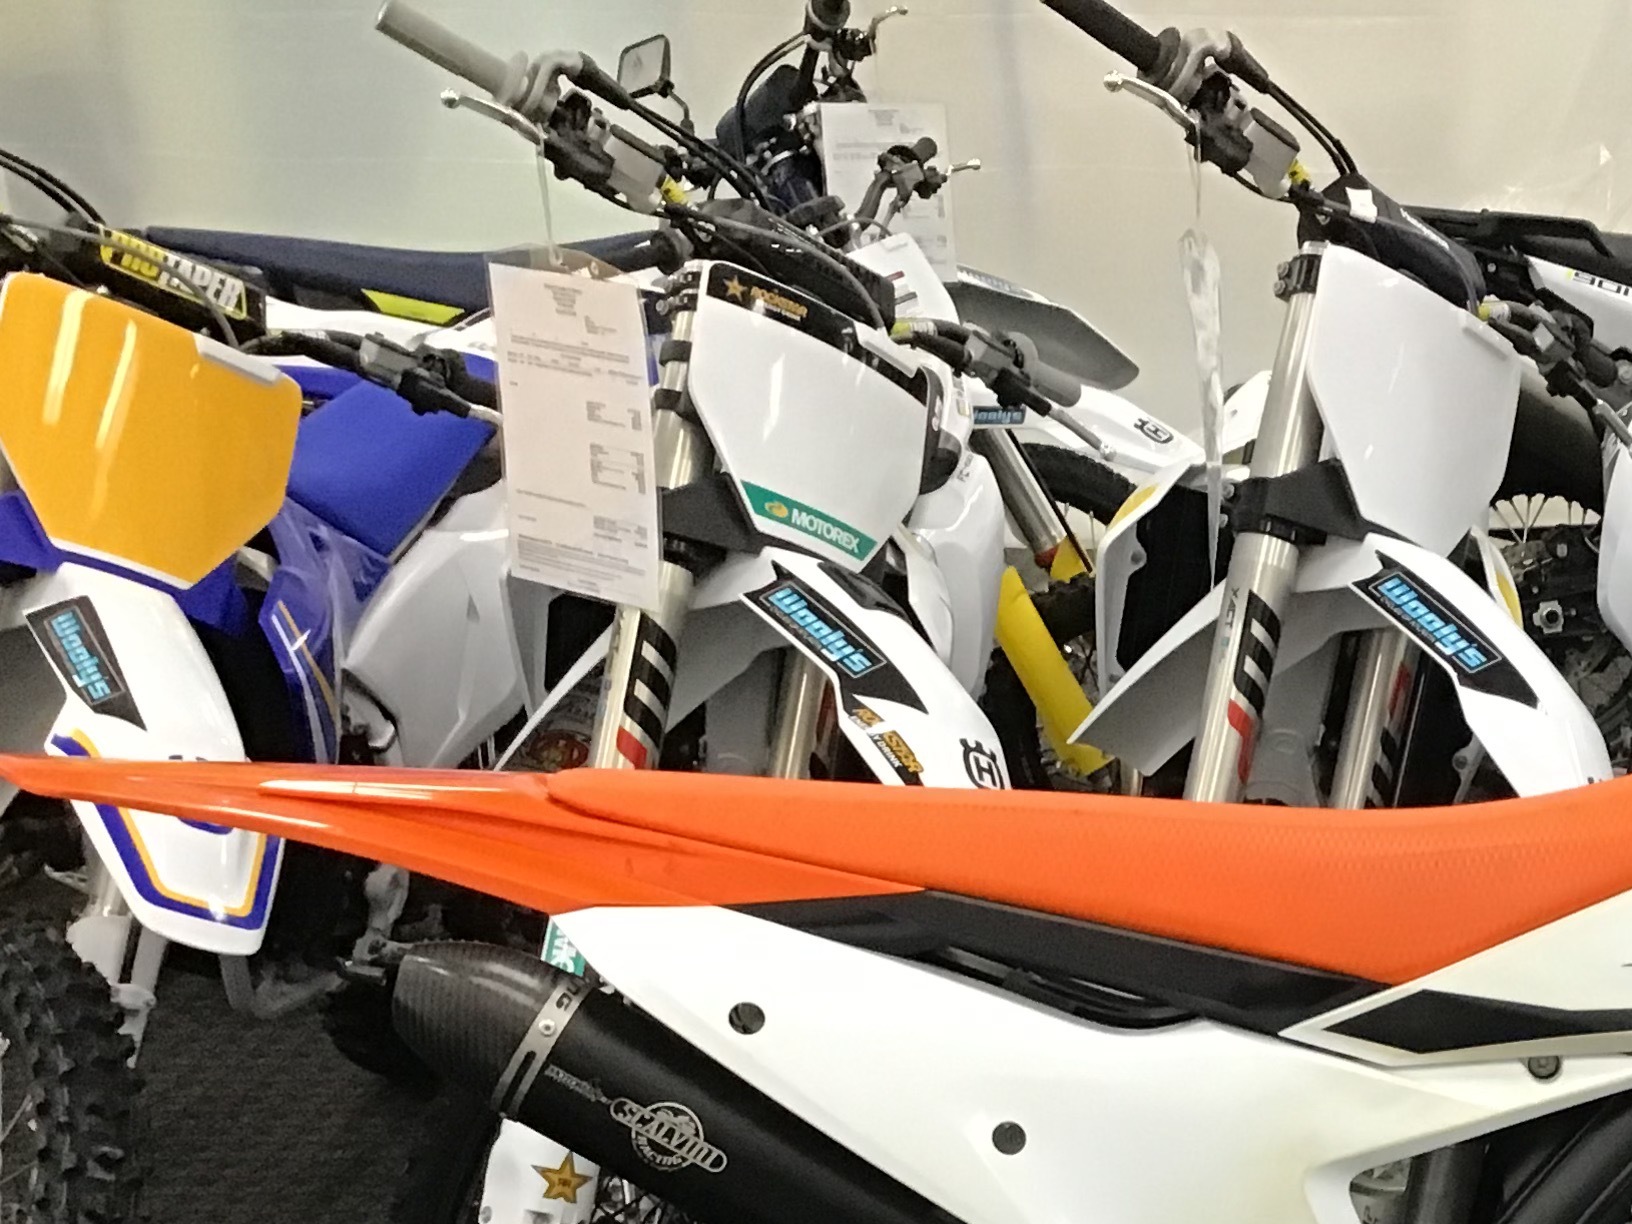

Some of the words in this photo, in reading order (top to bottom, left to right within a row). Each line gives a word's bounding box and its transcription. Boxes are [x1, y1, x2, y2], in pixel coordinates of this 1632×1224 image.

[791, 508, 860, 553] MOTOREX
[768, 587, 873, 672] Wooly's
[1377, 577, 1488, 668] Wooly's
[616, 1104, 722, 1168] SCALVINI
